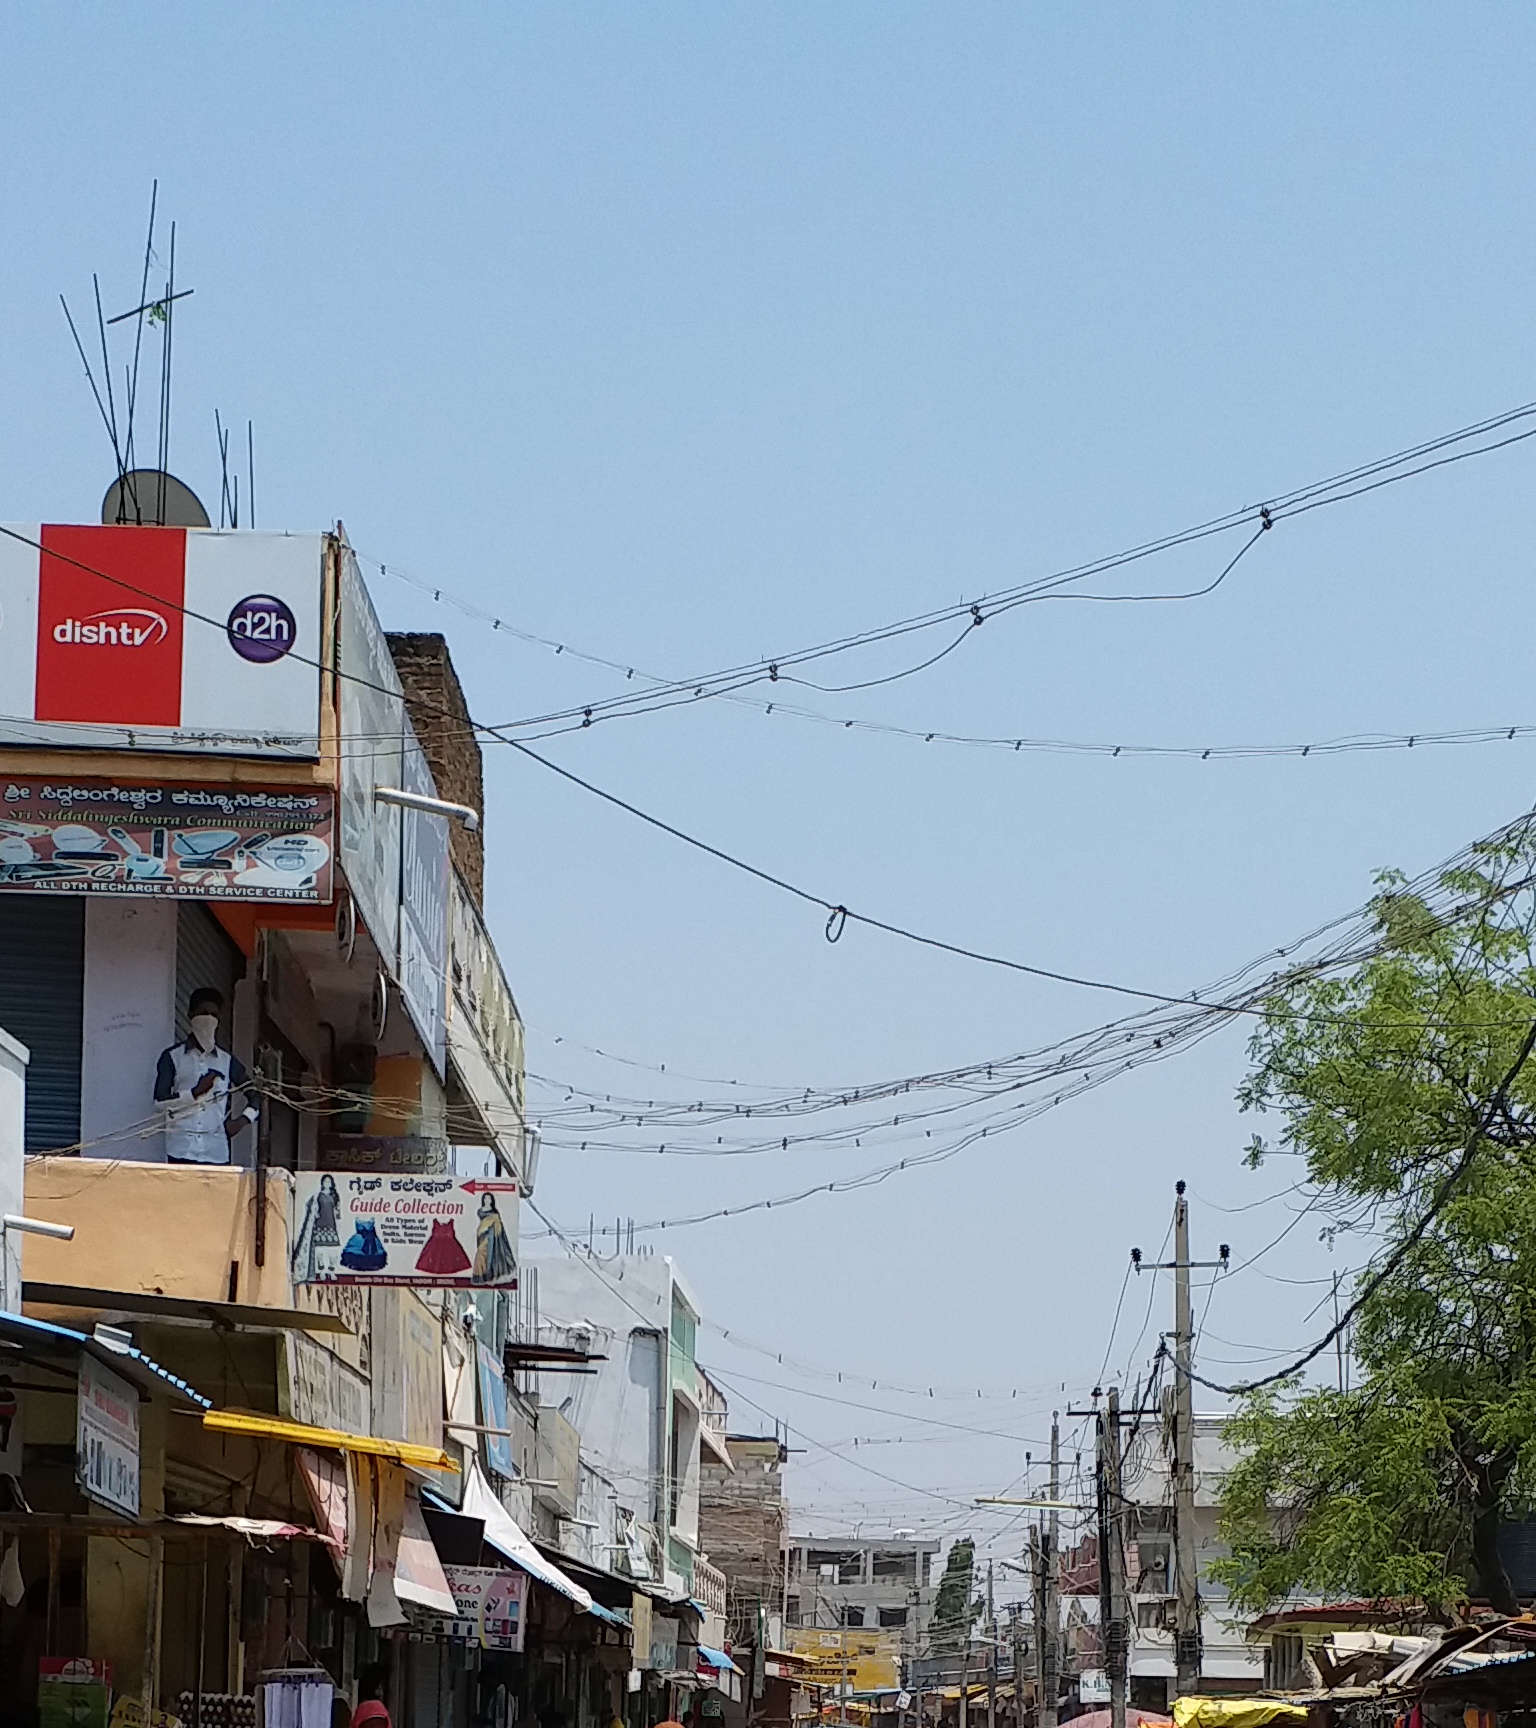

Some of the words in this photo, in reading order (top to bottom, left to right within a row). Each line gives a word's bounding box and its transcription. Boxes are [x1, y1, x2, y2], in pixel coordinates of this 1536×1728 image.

[54, 610, 167, 647] dishtv
[233, 610, 288, 642] d2h
[4, 784, 31, 802] ಶ್ರೀ
[8, 809, 32, 820] Sri
[37, 809, 180, 827] Siddalingeshwara
[186, 814, 315, 831] Communication
[34, 881, 57, 889] ALL
[62, 882, 88, 890] DTH
[92, 883, 161, 893] RECHARGE
[166, 885, 174, 893] &
[179, 885, 205, 894] DTH
[209, 886, 263, 896] SERVICE
[267, 888, 319, 898] CENTER
[349, 1177, 382, 1196] ಗೈಡ್
[350, 1197, 391, 1214] Guide
[395, 1198, 464, 1215] Collection
[396, 1217, 414, 1225] Types
[448, 1578, 482, 1595] kas
[455, 1597, 479, 1609] one
